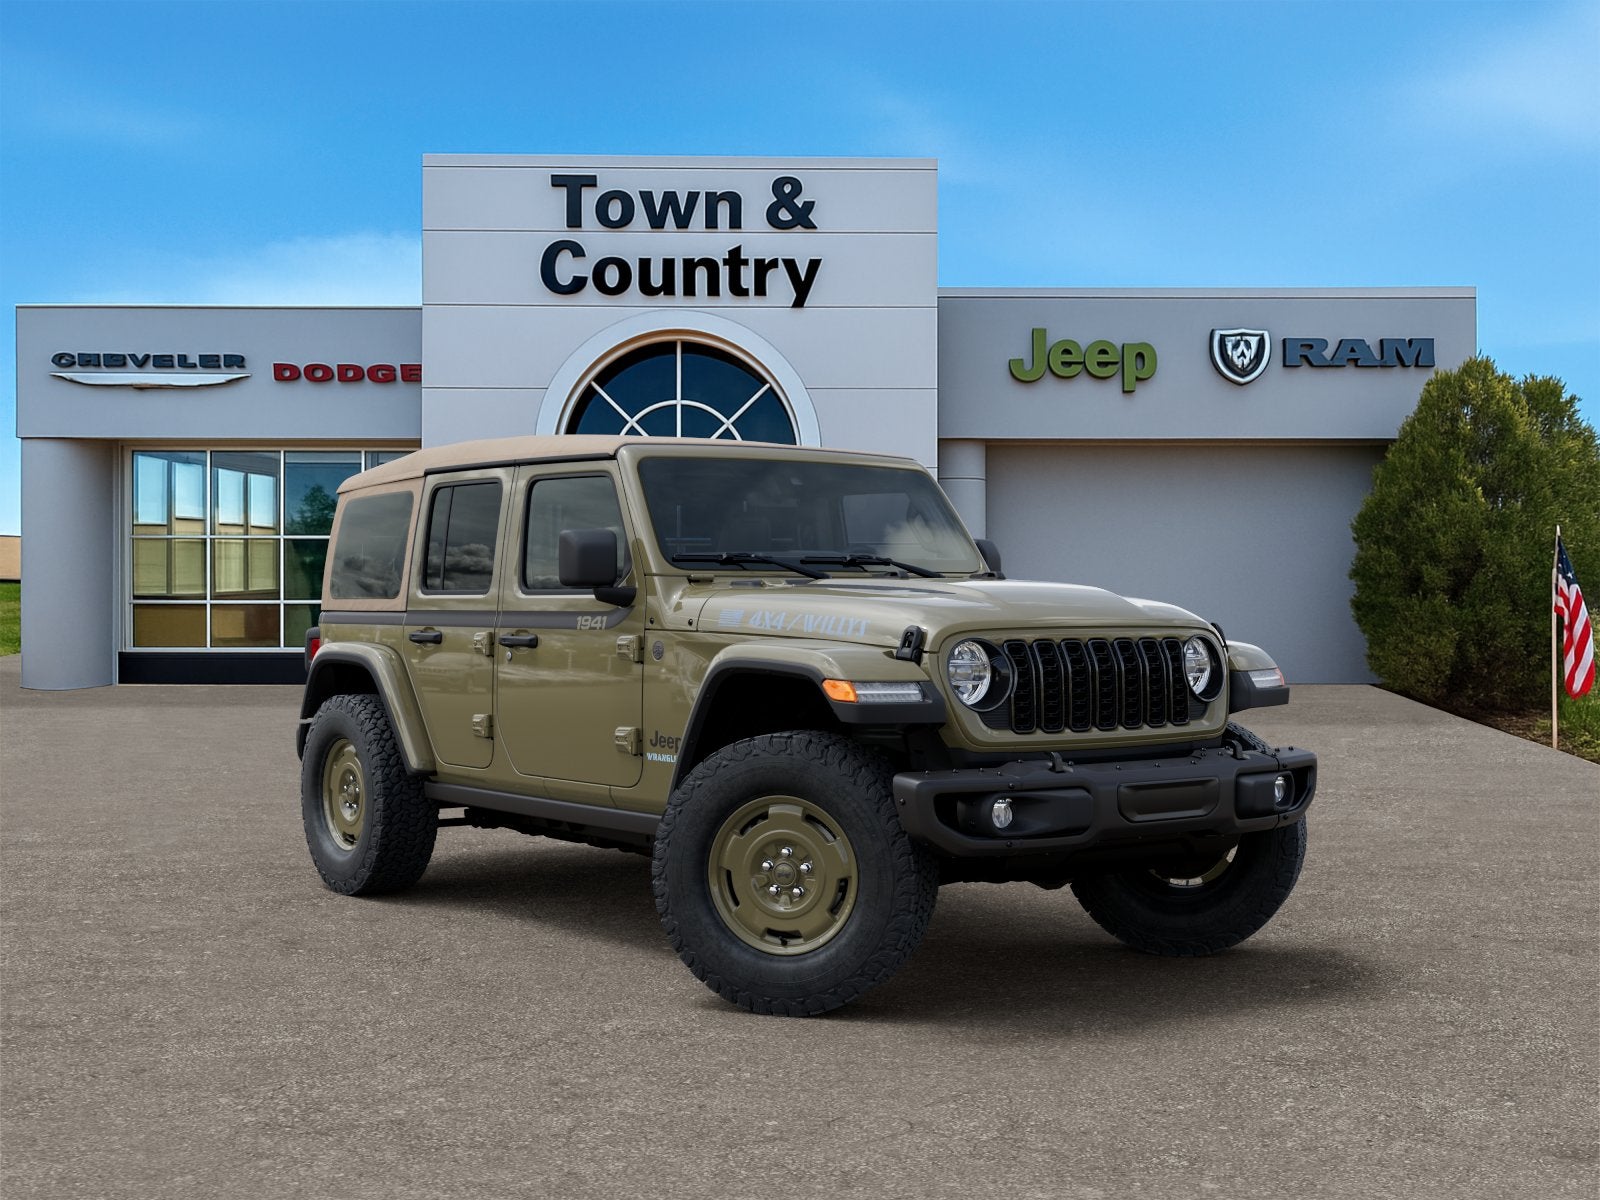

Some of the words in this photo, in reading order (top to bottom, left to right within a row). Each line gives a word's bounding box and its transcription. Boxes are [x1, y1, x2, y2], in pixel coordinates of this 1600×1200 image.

[550, 174, 742, 229] Town
[765, 175, 818, 230] &
[540, 239, 822, 308] Country
[272, 362, 422, 383] DODGE
[1008, 327, 1158, 393] Jeep
[1282, 337, 1435, 368] RAM
[576, 615, 608, 630] 1941
